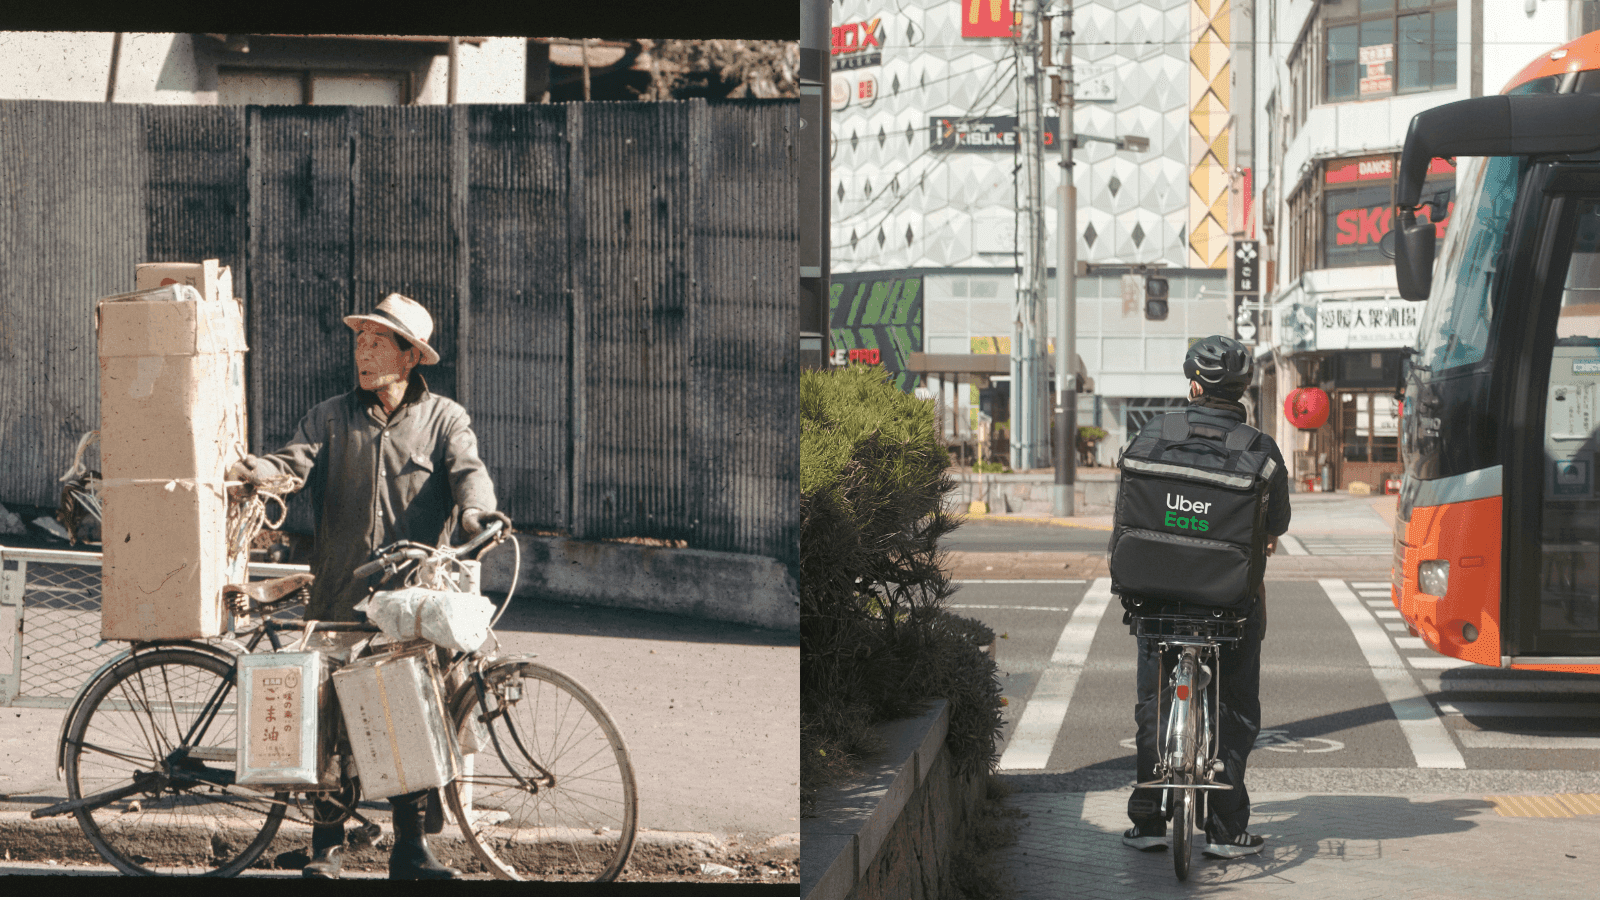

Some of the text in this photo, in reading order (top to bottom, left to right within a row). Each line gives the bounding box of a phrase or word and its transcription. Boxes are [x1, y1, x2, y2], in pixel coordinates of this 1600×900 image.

[1359, 160, 1393, 175] DANCE
[1166, 493, 1212, 514] Uber
[1165, 511, 1209, 532] Eats
[263, 688, 279, 742] ごま油
